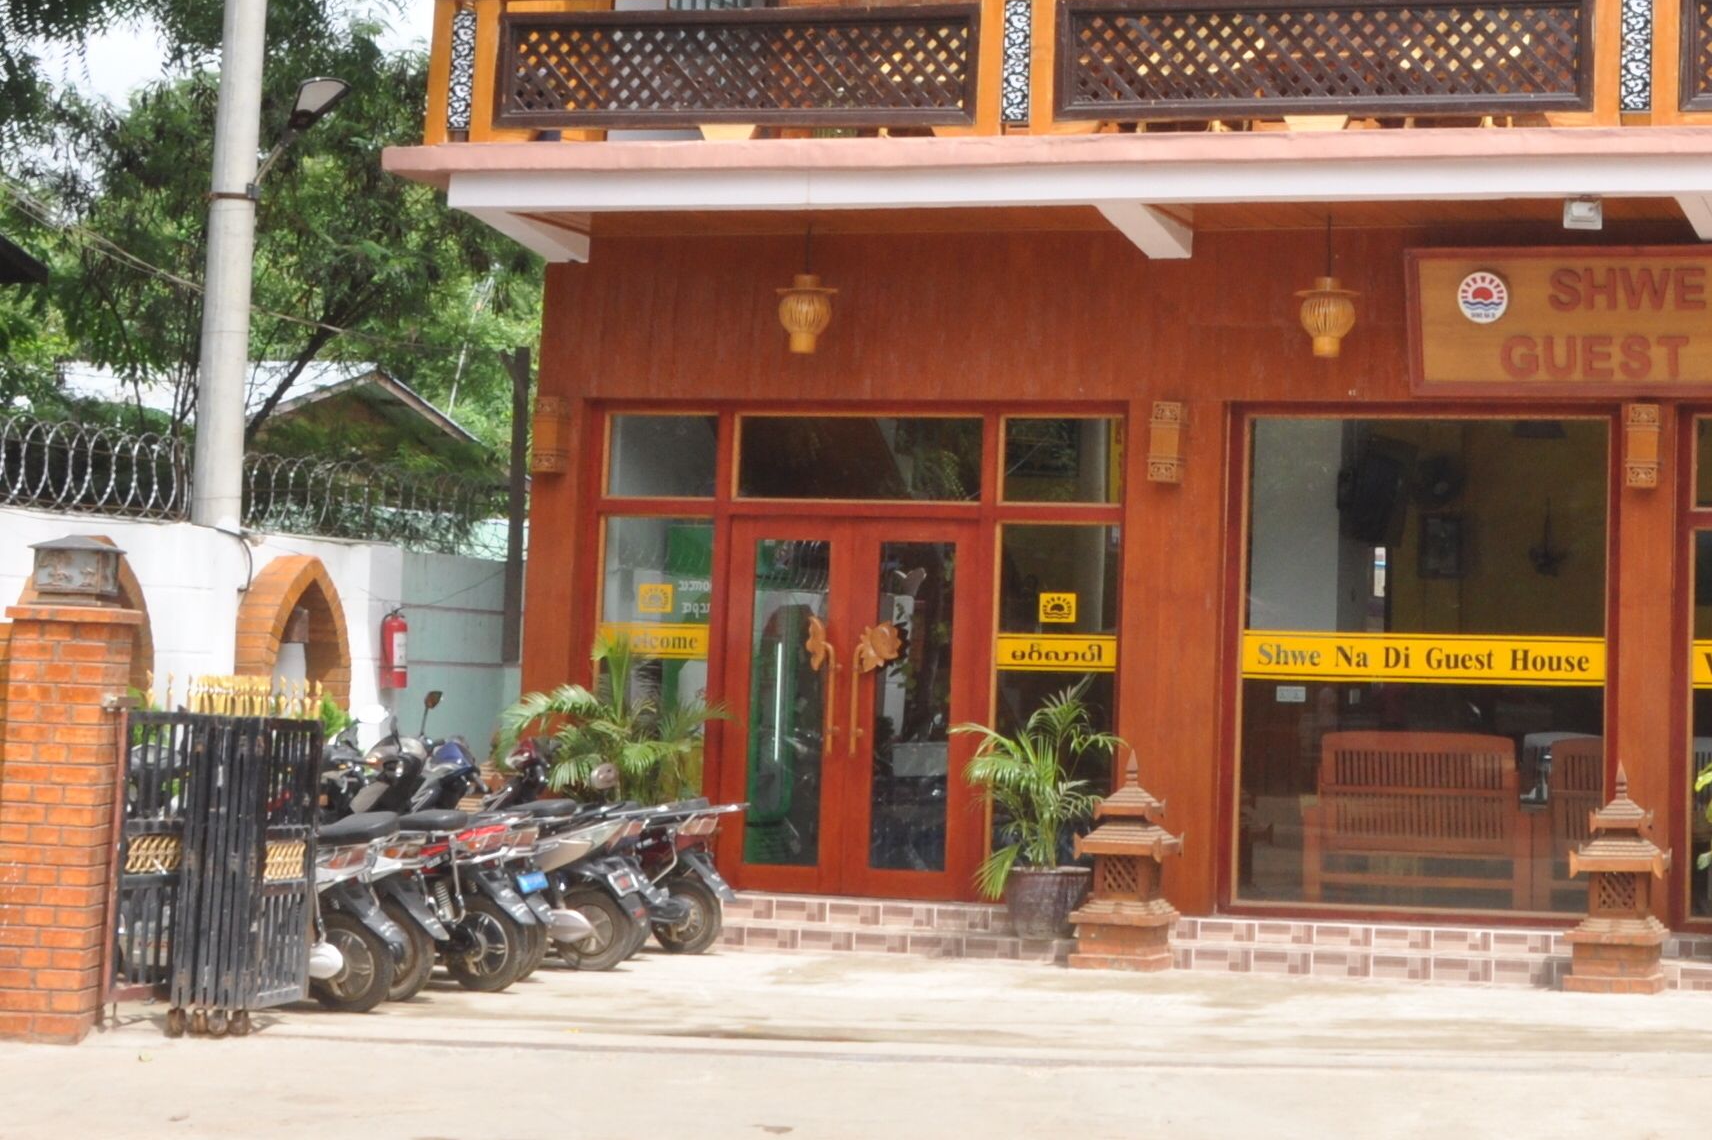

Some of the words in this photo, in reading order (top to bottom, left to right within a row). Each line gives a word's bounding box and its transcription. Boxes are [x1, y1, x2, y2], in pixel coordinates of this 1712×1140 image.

[1548, 265, 1706, 314] SHWE
[1500, 334, 1690, 382] GUEST
[1256, 642, 1321, 667] Shwe
[1334, 645, 1369, 669] Na
[1383, 645, 1411, 669] Di
[1425, 646, 1494, 671] Guest
[1509, 648, 1590, 672] House
